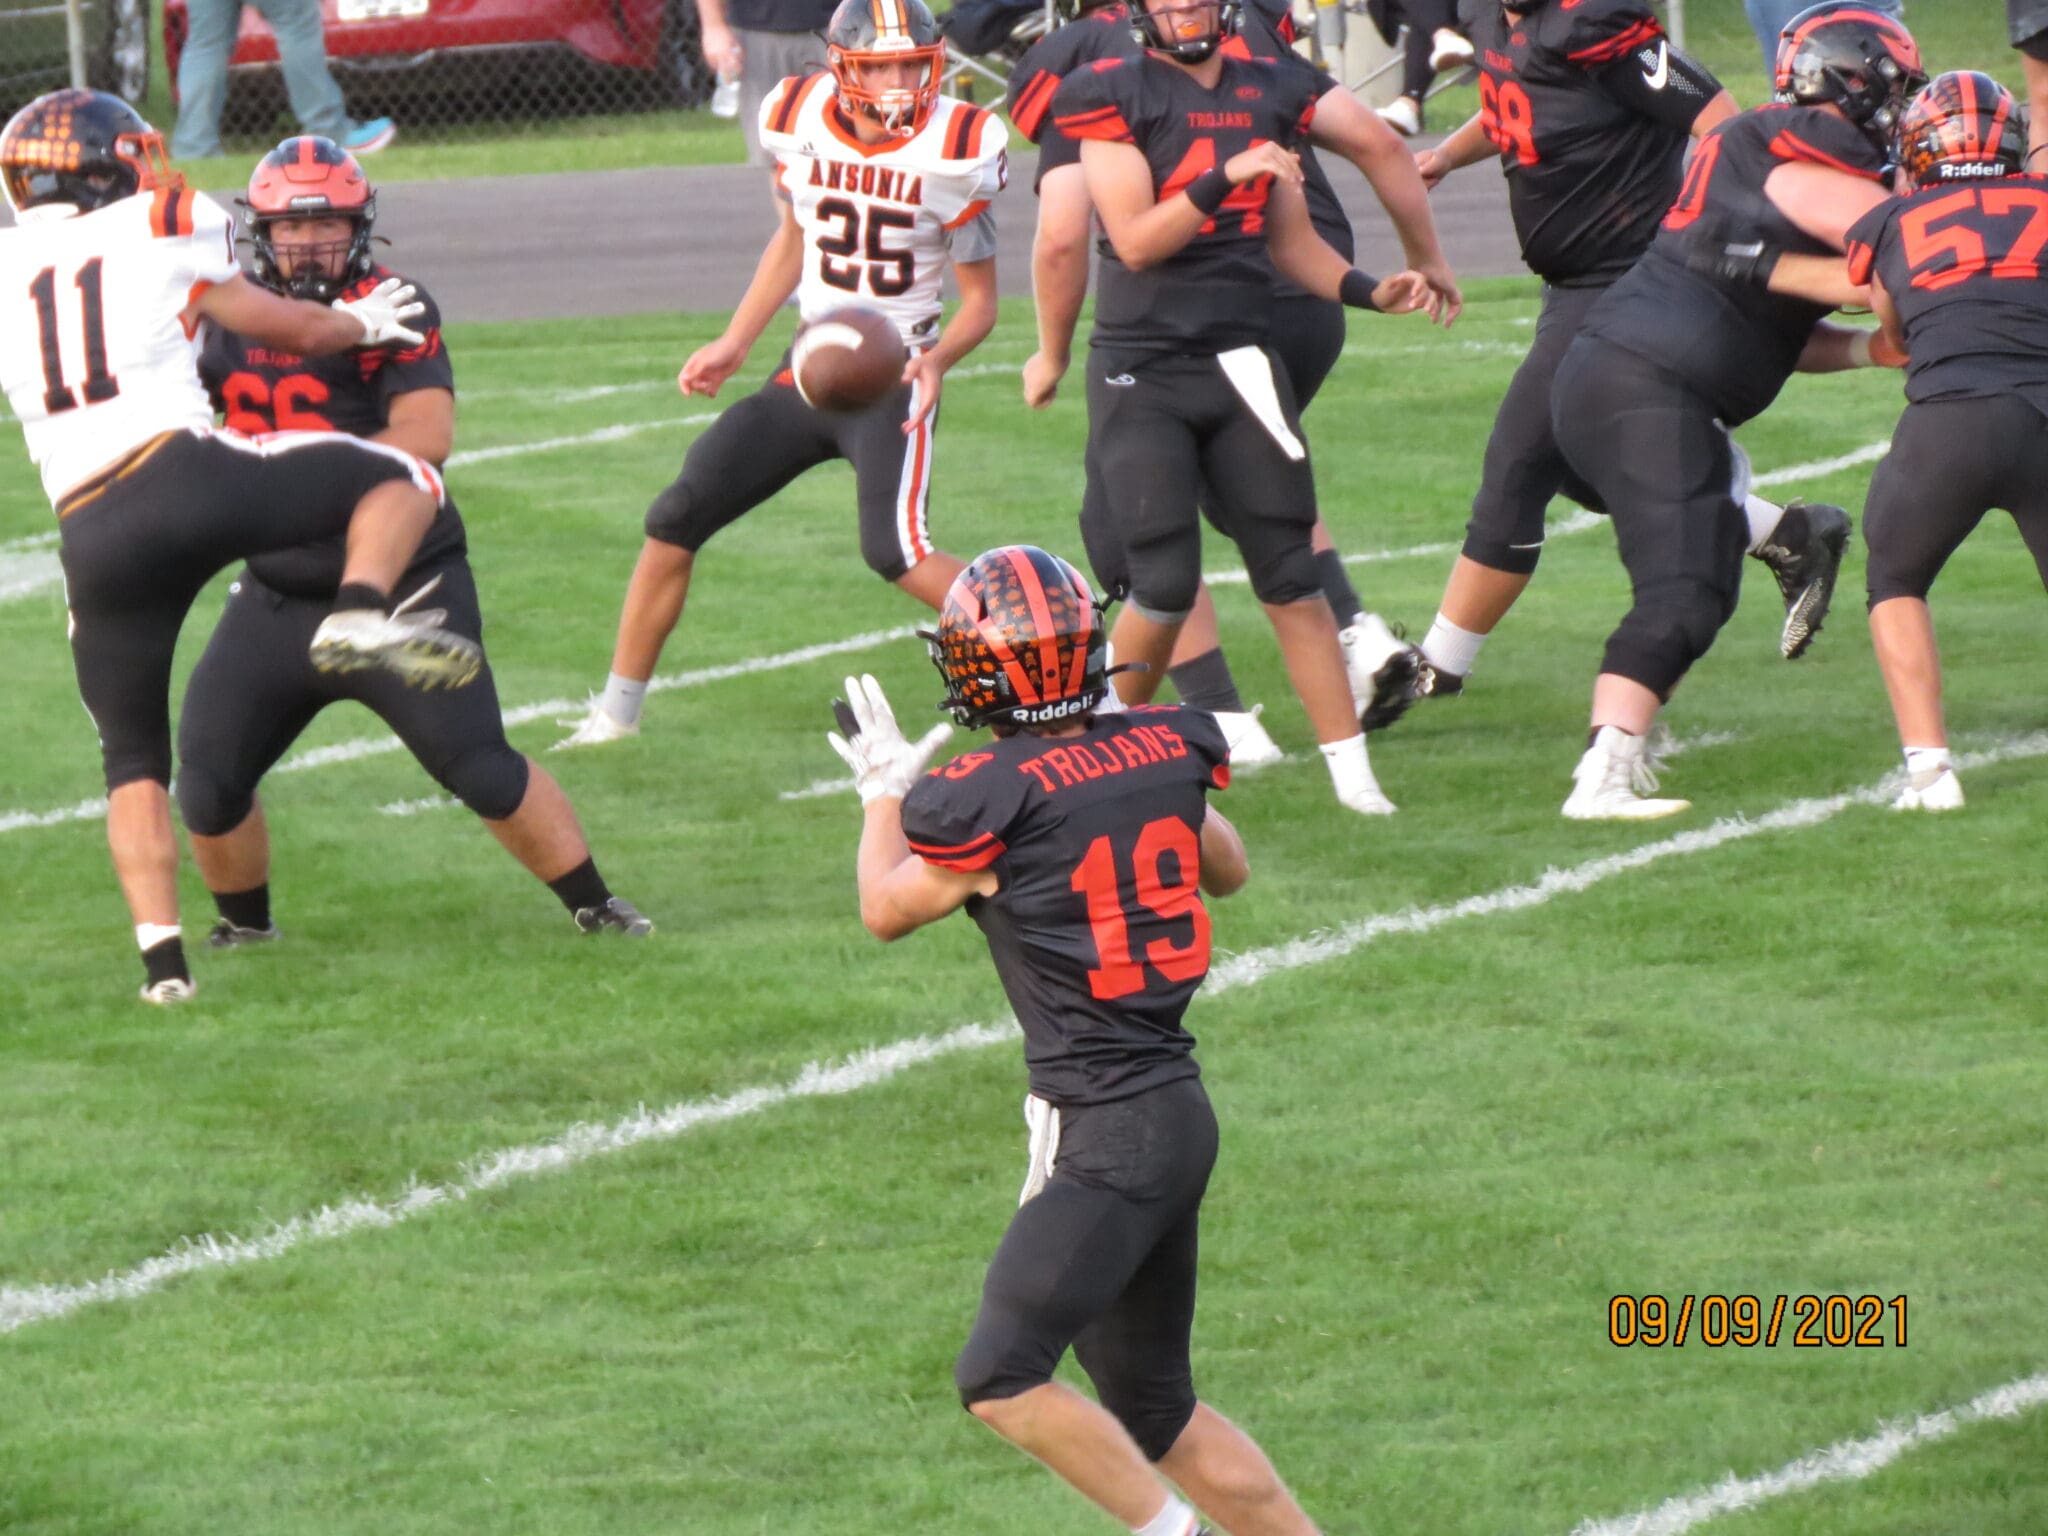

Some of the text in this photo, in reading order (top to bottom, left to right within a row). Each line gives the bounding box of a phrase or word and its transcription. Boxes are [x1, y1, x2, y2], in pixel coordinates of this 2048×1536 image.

[1187, 112, 1252, 128] TROJANS
[807, 157, 923, 206] ANSONIA
[1940, 162, 2006, 178] Riddell
[815, 197, 915, 297] 25
[1898, 188, 2048, 291] 57
[29, 255, 120, 416] 11
[221, 372, 335, 432] 66
[1011, 694, 1094, 723] Riddell
[929, 752, 995, 781] 9
[1018, 724, 1188, 793] TROJANS
[1071, 815, 1212, 1001] 19
